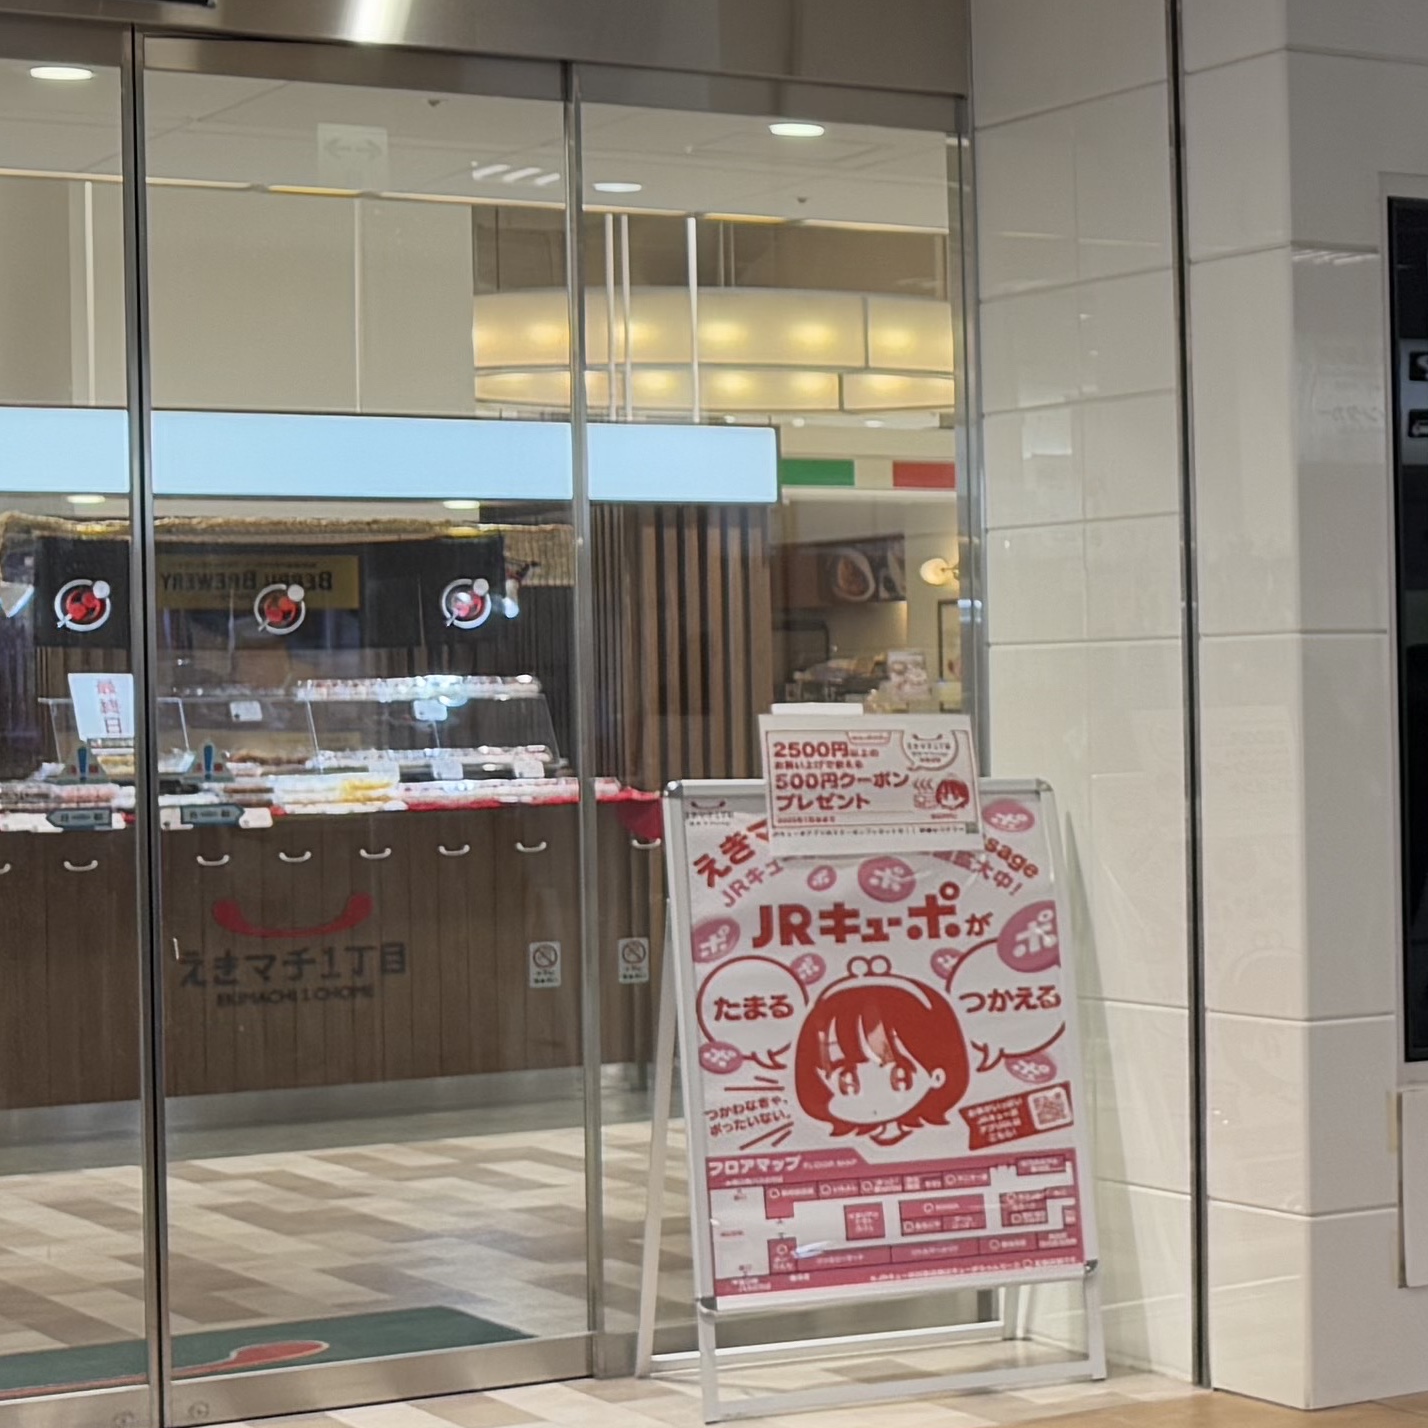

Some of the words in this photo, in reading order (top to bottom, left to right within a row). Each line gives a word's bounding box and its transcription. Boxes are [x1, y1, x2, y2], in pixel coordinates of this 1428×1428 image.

[775, 770, 910, 791] 500円クーポン
[776, 792, 871, 812] プレゼント
[700, 924, 730, 960] ポ
[1013, 908, 1058, 958] ポ
[179, 942, 406, 988] えきマチ1丁目
[714, 994, 794, 1021] たまる
[959, 985, 1062, 1013] つかえる
[709, 1155, 801, 1175] フロアマップ
